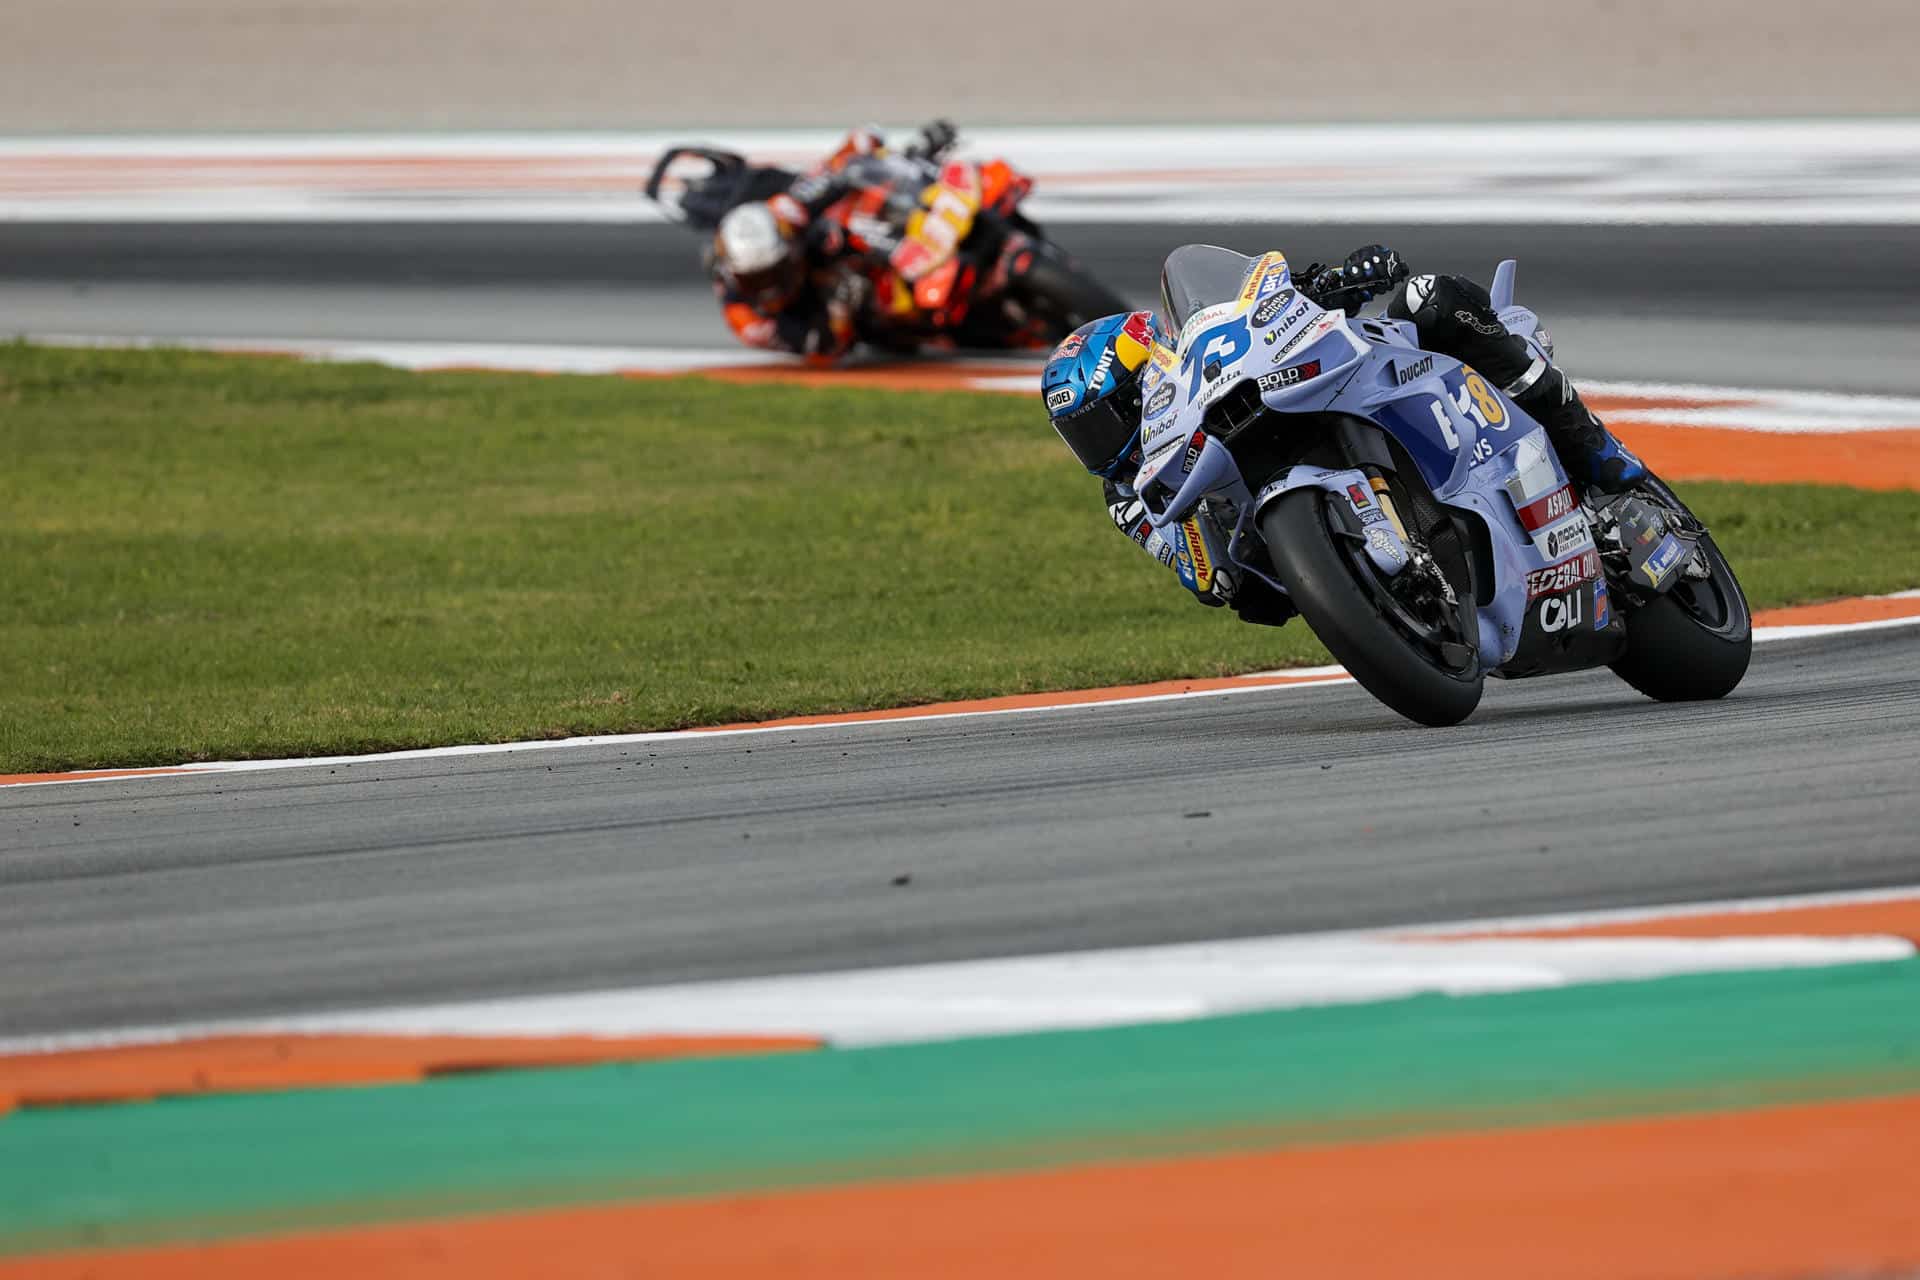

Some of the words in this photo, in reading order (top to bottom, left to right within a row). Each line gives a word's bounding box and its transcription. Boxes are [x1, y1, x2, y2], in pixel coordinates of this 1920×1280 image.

[1264, 302, 1310, 345] Unibat
[1181, 314, 1252, 406] 73
[1400, 355, 1433, 385] DUCATI
[1257, 367, 1299, 391] BOLD
[1048, 390, 1071, 408] SHOEI
[1144, 414, 1178, 444] Unibat
[1583, 553, 1597, 579] OIL
